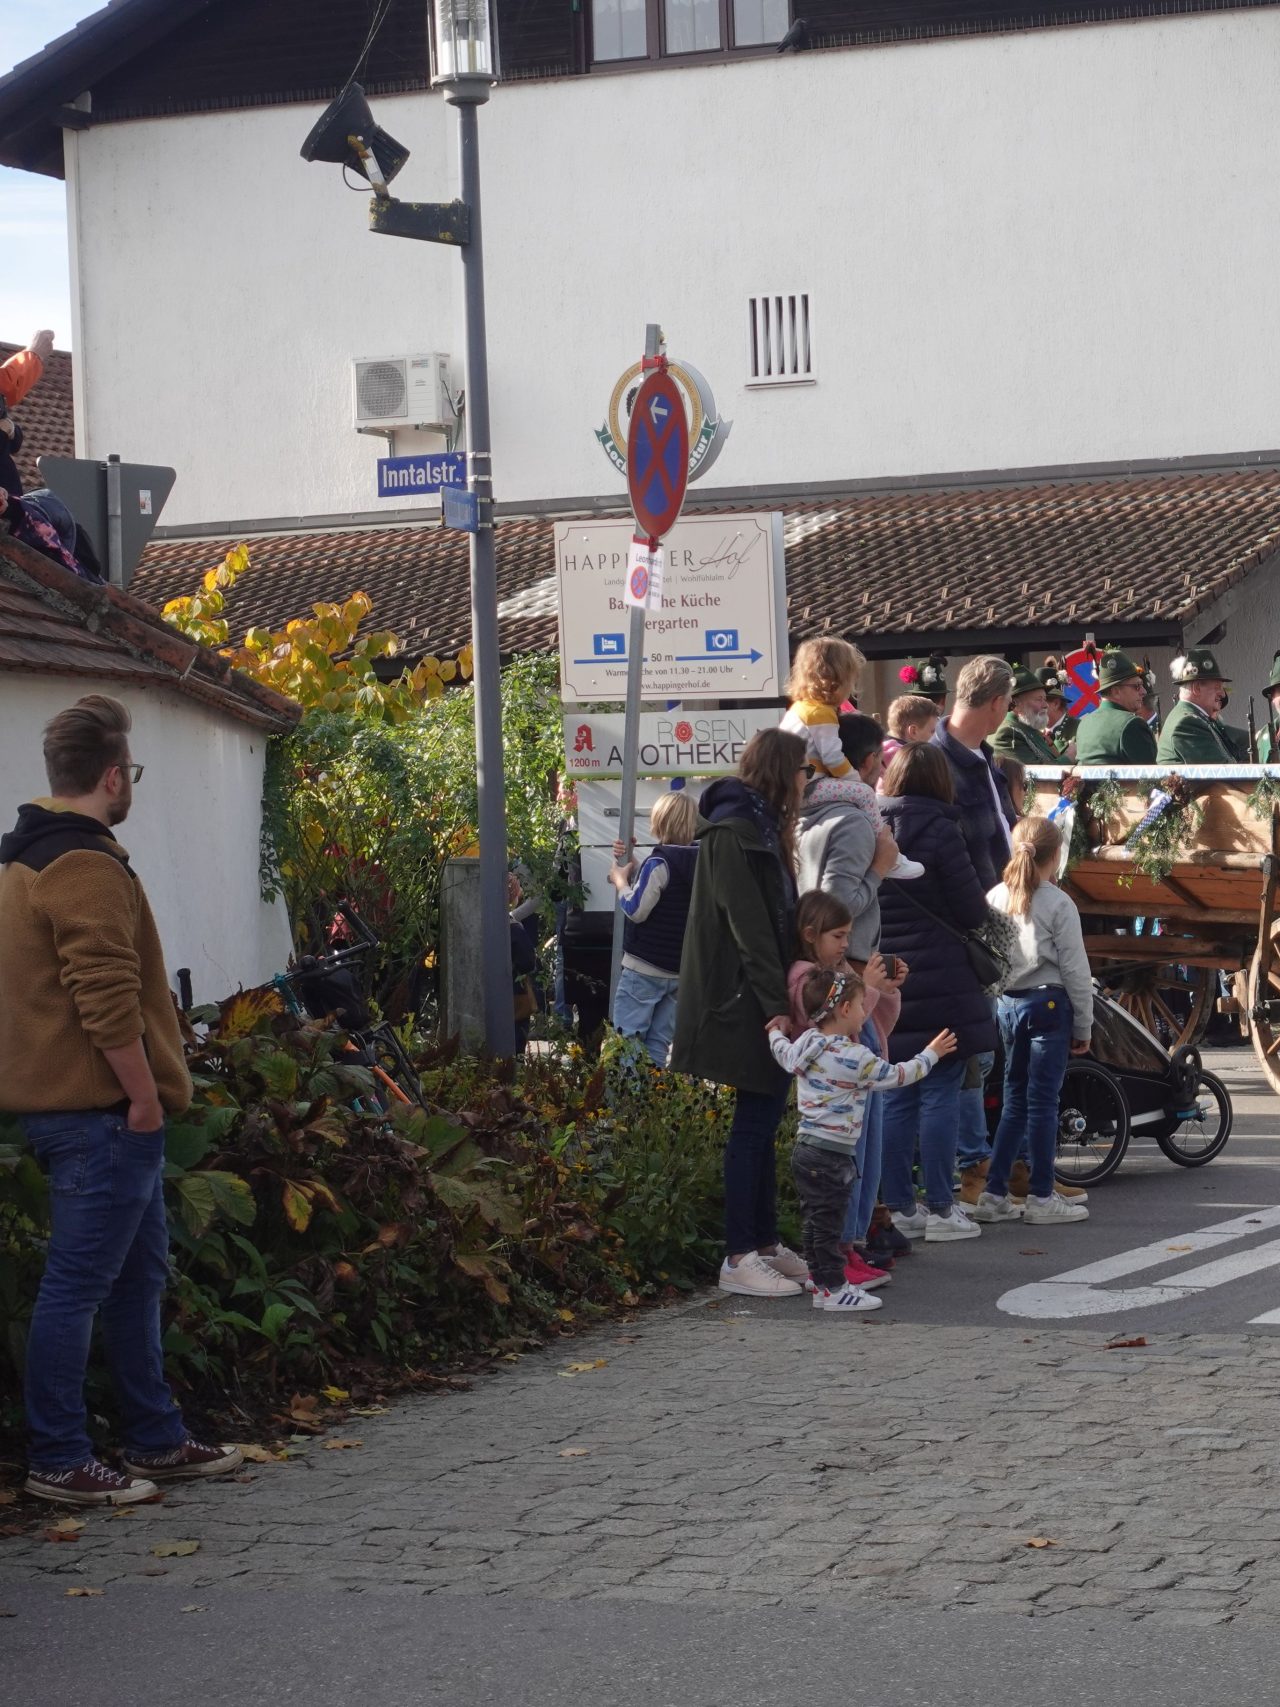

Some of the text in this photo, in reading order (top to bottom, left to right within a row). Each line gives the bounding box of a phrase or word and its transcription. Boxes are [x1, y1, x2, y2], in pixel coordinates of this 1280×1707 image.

[605, 440, 627, 473] Loc
[688, 434, 708, 471] atur
[383, 461, 462, 488] Inntalstr.
[565, 532, 762, 580] HAPPIER Hof
[608, 594, 677, 613] Bayhe
[681, 593, 721, 607] Küche
[645, 616, 699, 634] ergarten
[651, 653, 674, 662] 50 m
[670, 667, 690, 675] 11.30
[697, 666, 718, 674] 21.00
[719, 665, 734, 673] Uhr
[641, 680, 711, 691] ww.happingerhof.de
[569, 758, 601, 768] 1200 m
[607, 742, 744, 767] AOTHEKE
